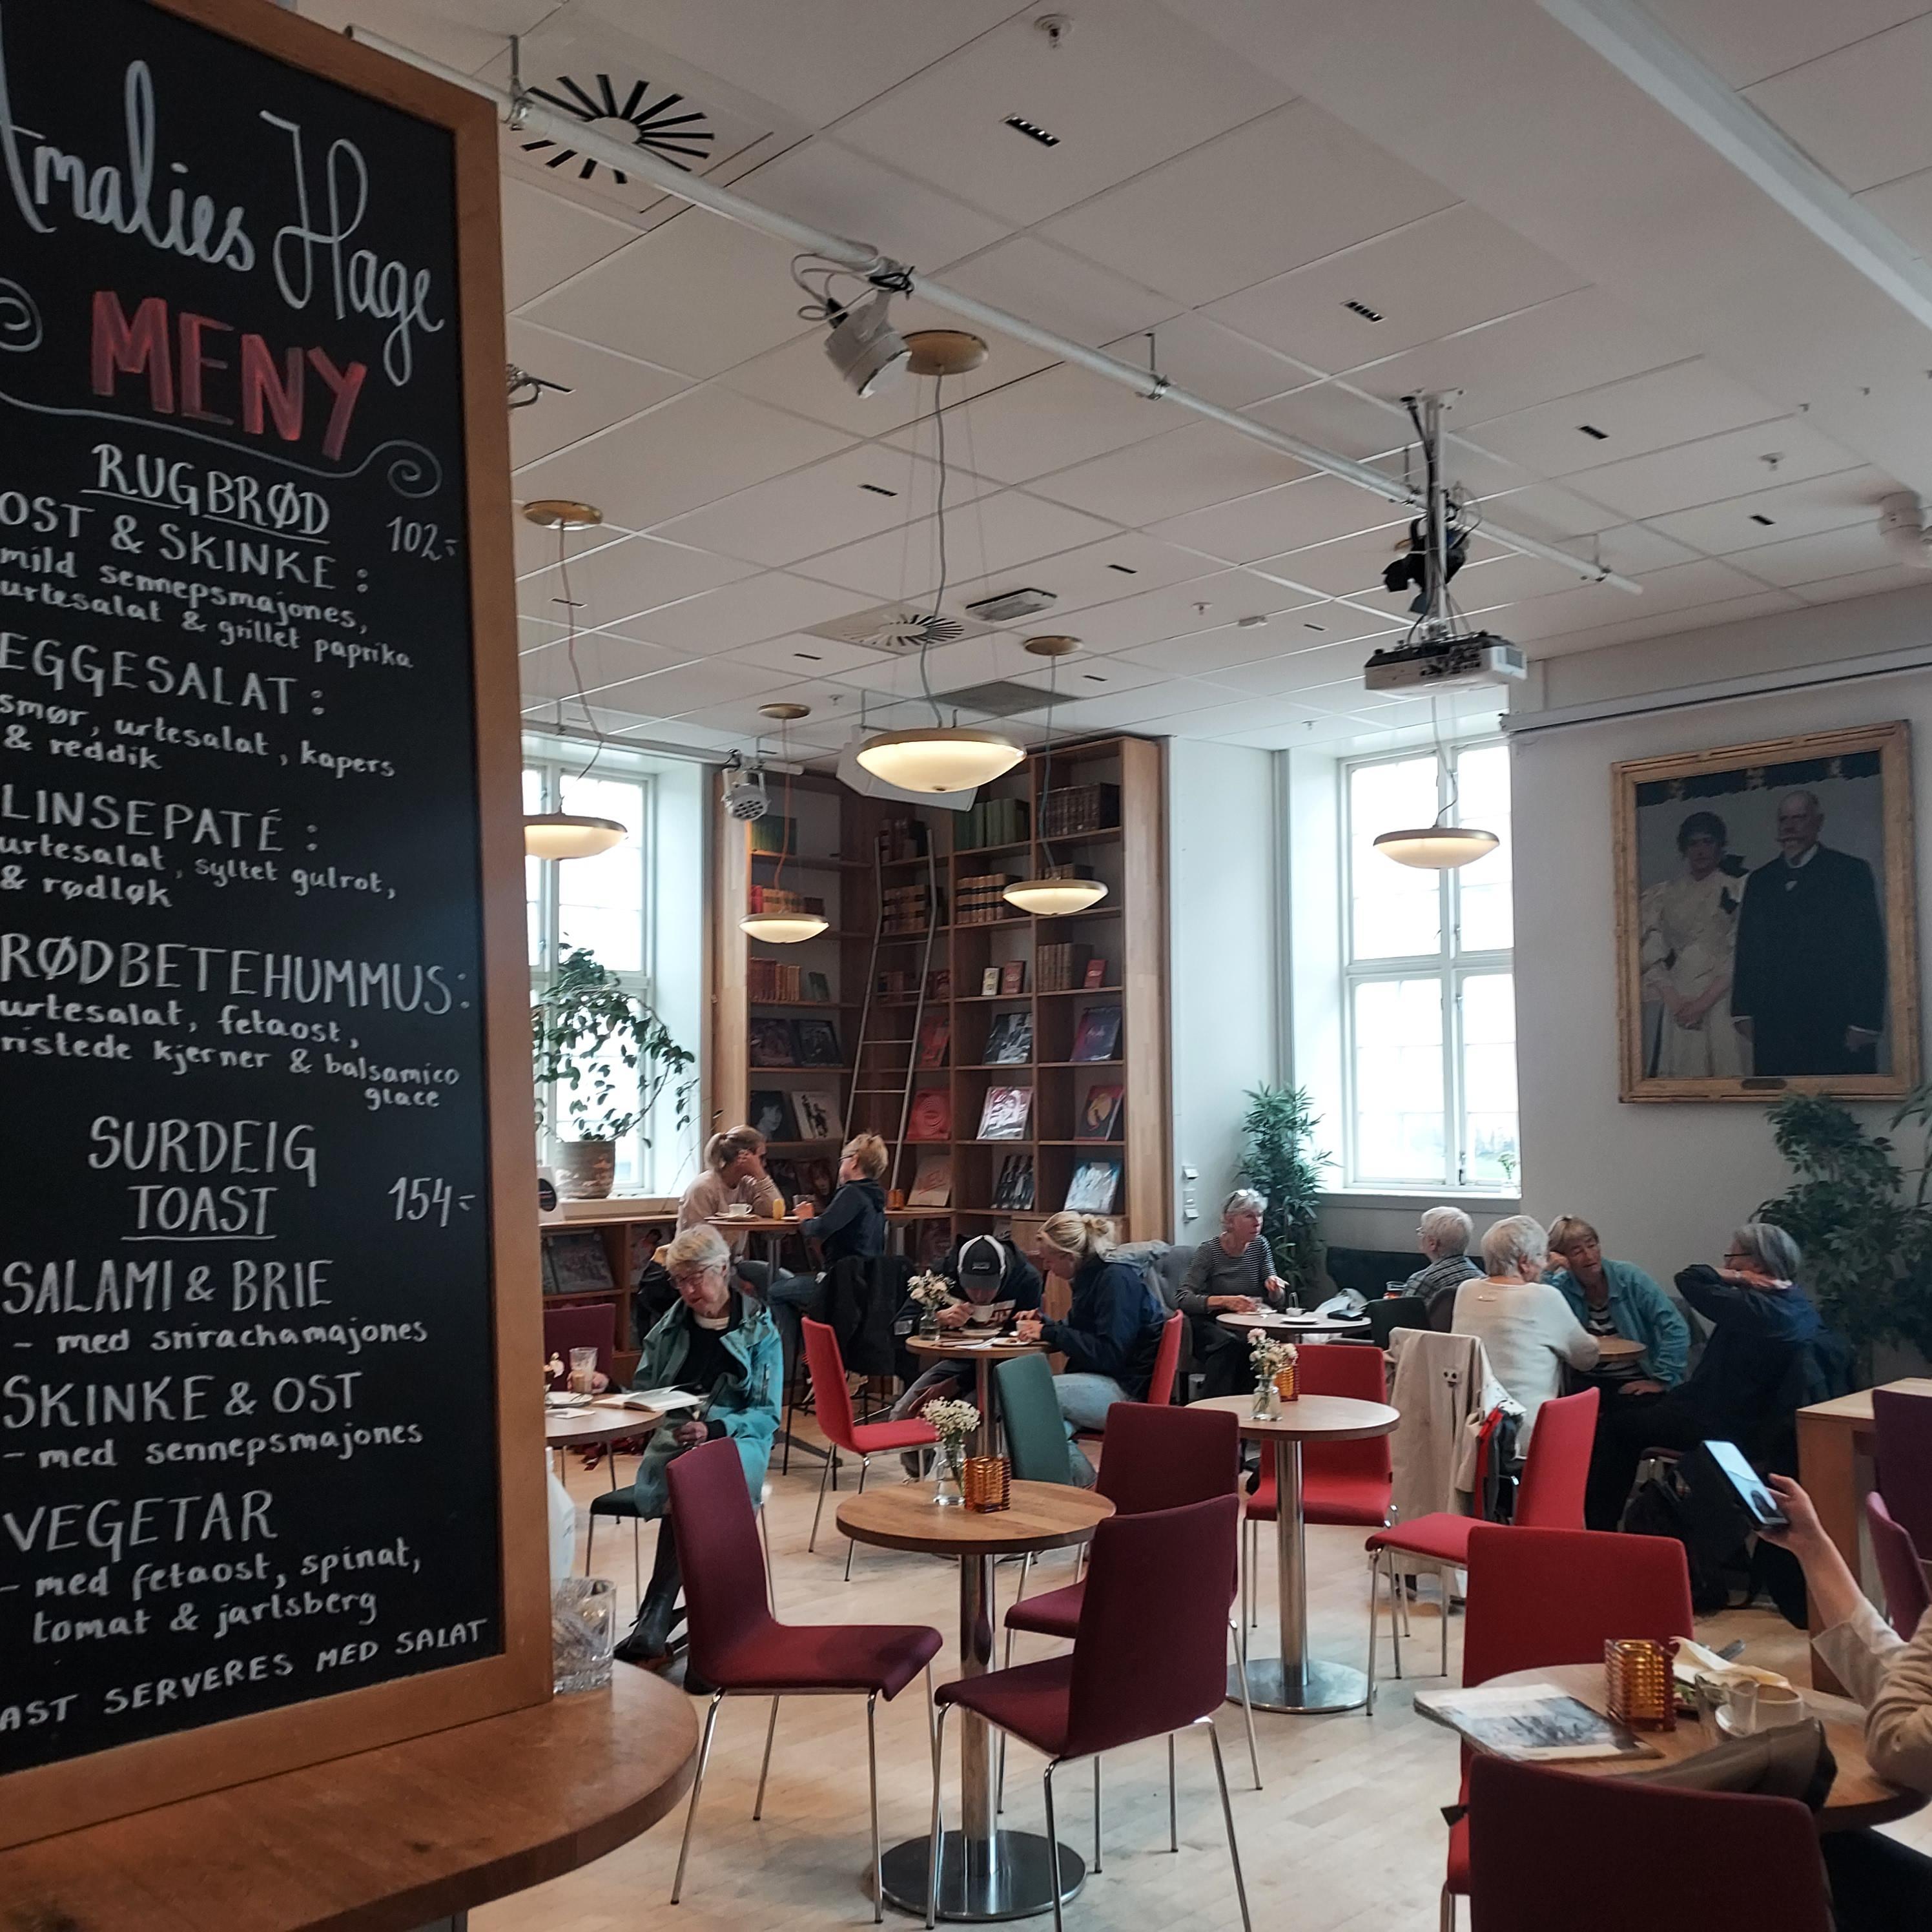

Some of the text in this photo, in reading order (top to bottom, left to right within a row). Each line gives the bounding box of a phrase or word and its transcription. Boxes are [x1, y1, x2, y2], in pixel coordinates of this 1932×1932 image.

[260, 110, 444, 386] Hage
[92, 291, 367, 460] MENY
[92, 444, 329, 535] RUGBRØD
[1, 491, 95, 537] OST
[110, 516, 143, 553] &
[0, 546, 77, 578] mild
[0, 581, 413, 673] urtesalat & grillet paprika
[5, 724, 162, 770] & reddik
[301, 741, 395, 777] kapers
[1, 865, 172, 907] & rødløk
[195, 858, 278, 886] syltet
[291, 867, 395, 899] gulrot,
[0, 1027, 459, 1085] ristede kjerner & balsamico
[365, 1087, 439, 1110] glace
[89, 1116, 316, 1187] SURDEIG
[128, 1185, 278, 1234] TOAST
[1, 1260, 334, 1314] SALAMI & BRIE
[57, 1328, 129, 1355] med
[3, 1370, 362, 1430] SKINKE & OST
[39, 1440, 117, 1468] med
[145, 1423, 423, 1466] sennepsmajones
[3, 1490, 278, 1563] VEGETAR
[35, 1567, 110, 1598] med
[132, 1553, 285, 1601] fetaost,
[301, 1537, 421, 1585] spinat,
[33, 1591, 377, 1644] tomat & jarlsberg
[103, 1653, 294, 1715] SERVERES
[316, 1639, 378, 1672] MED
[395, 1618, 488, 1656] SALAT
